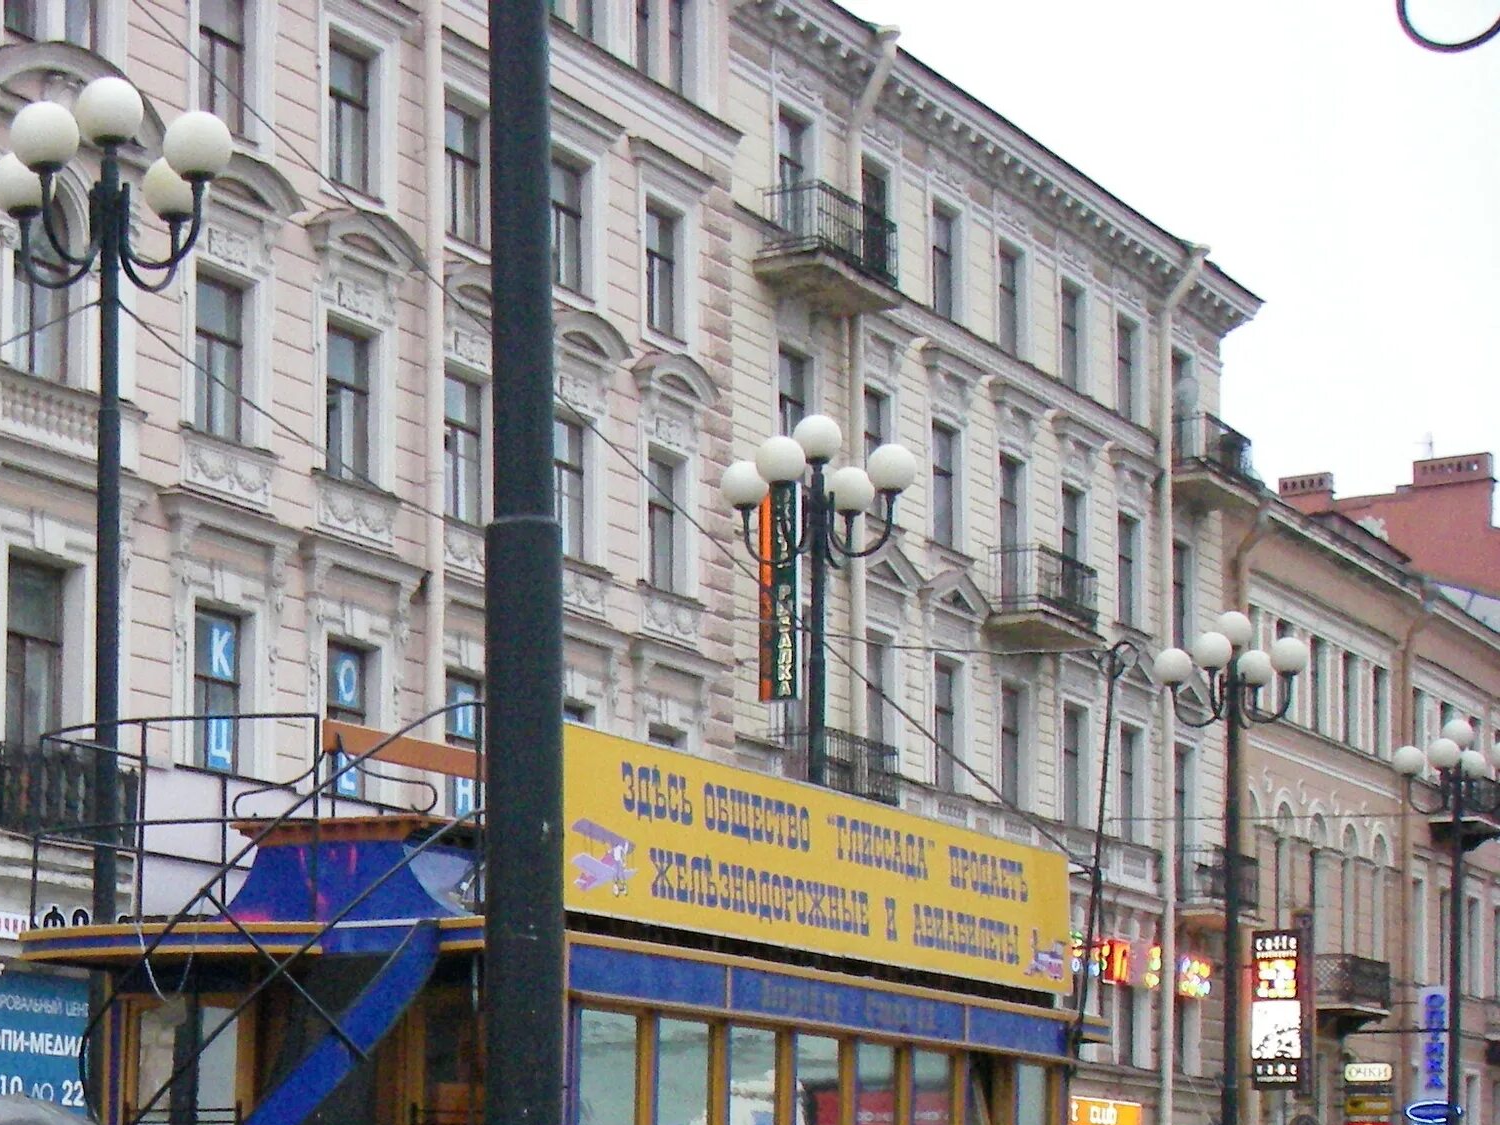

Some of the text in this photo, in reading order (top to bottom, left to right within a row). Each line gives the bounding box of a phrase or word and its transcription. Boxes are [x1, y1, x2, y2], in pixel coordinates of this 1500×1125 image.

[703, 782, 810, 853] ОБЩЕСТВО
[884, 896, 897, 942] И
[913, 903, 1020, 965] АВИАБИЛЕТЫ
[61, 1079, 85, 1107] 22
